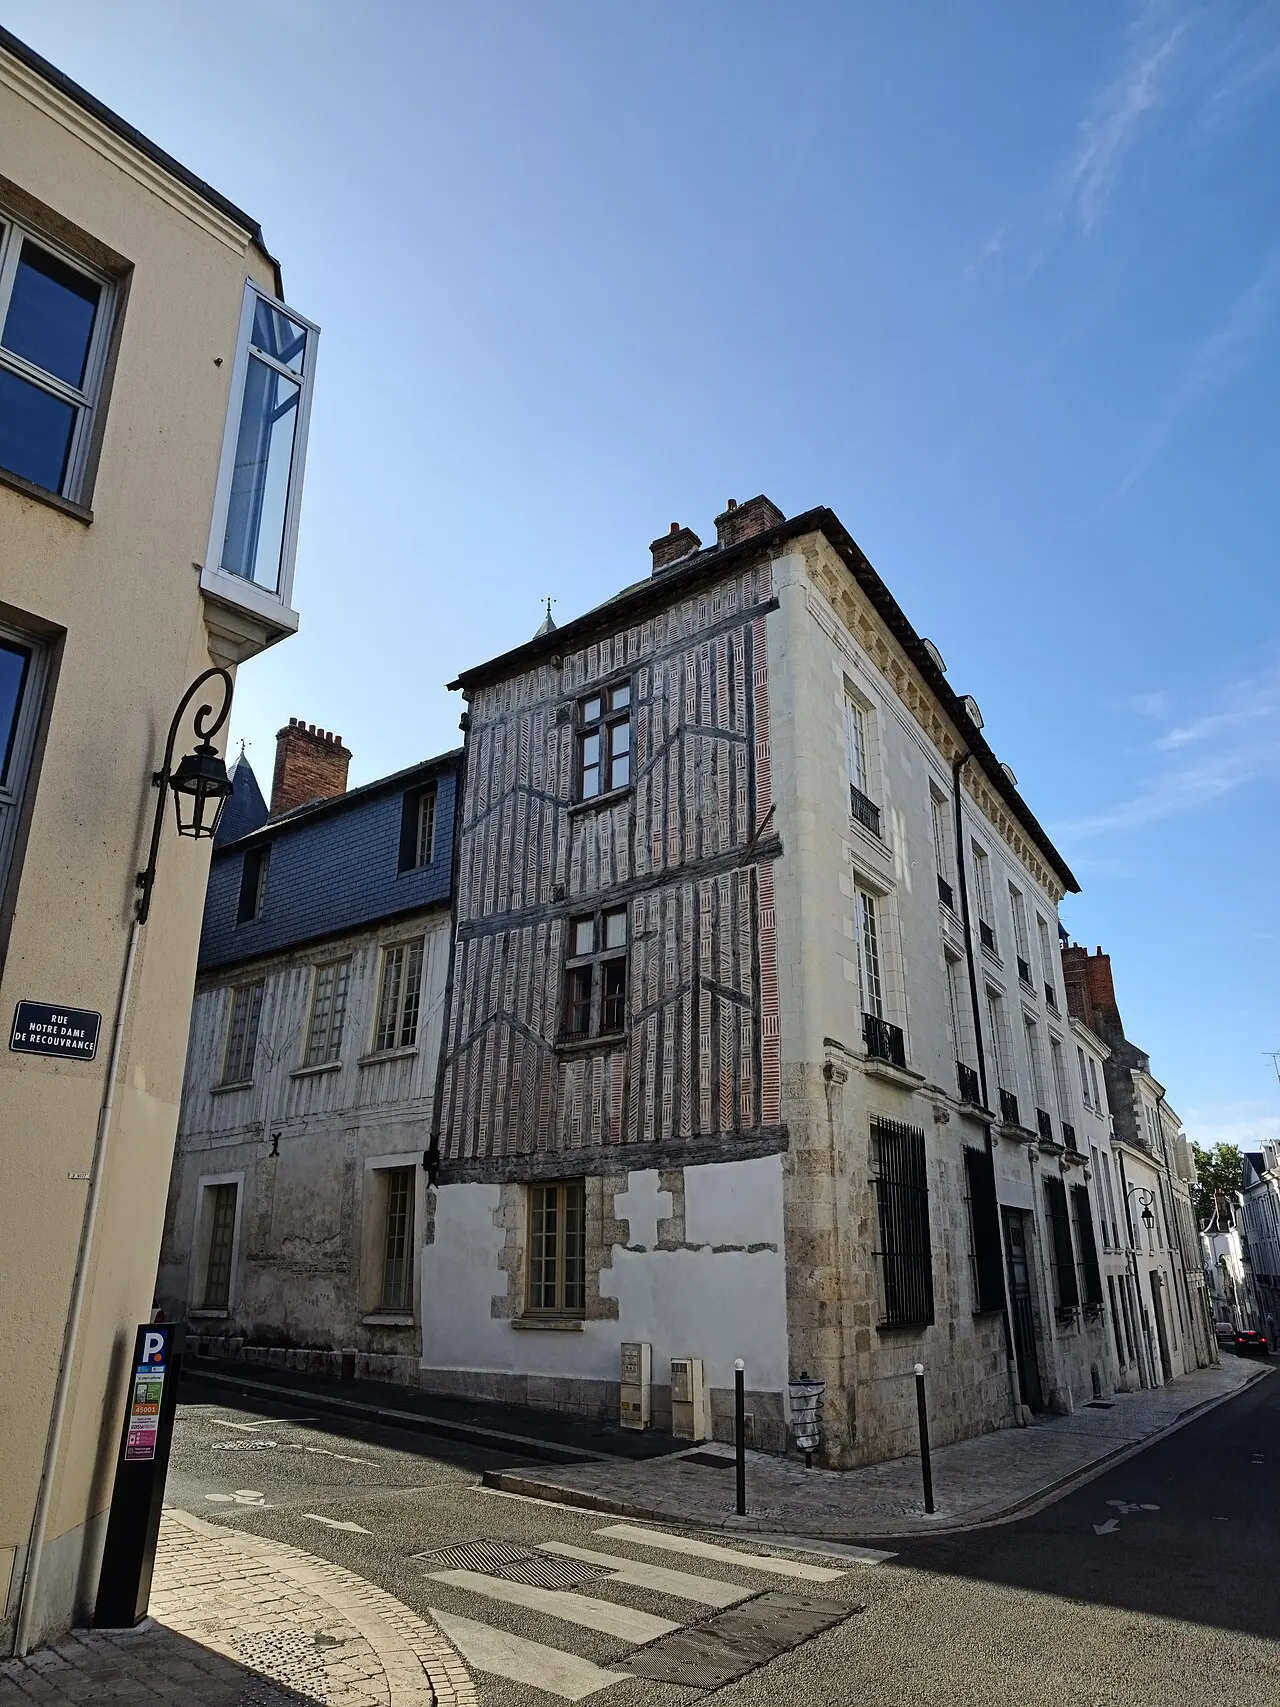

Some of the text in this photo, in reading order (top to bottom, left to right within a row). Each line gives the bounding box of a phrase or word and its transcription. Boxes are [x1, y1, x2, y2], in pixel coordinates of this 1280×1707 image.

[51, 1015, 68, 1024] RUE
[29, 1022, 85, 1038] NOTRE DAME
[15, 1032, 94, 1050] DE RECOUVRANCE
[142, 1332, 164, 1363] P
